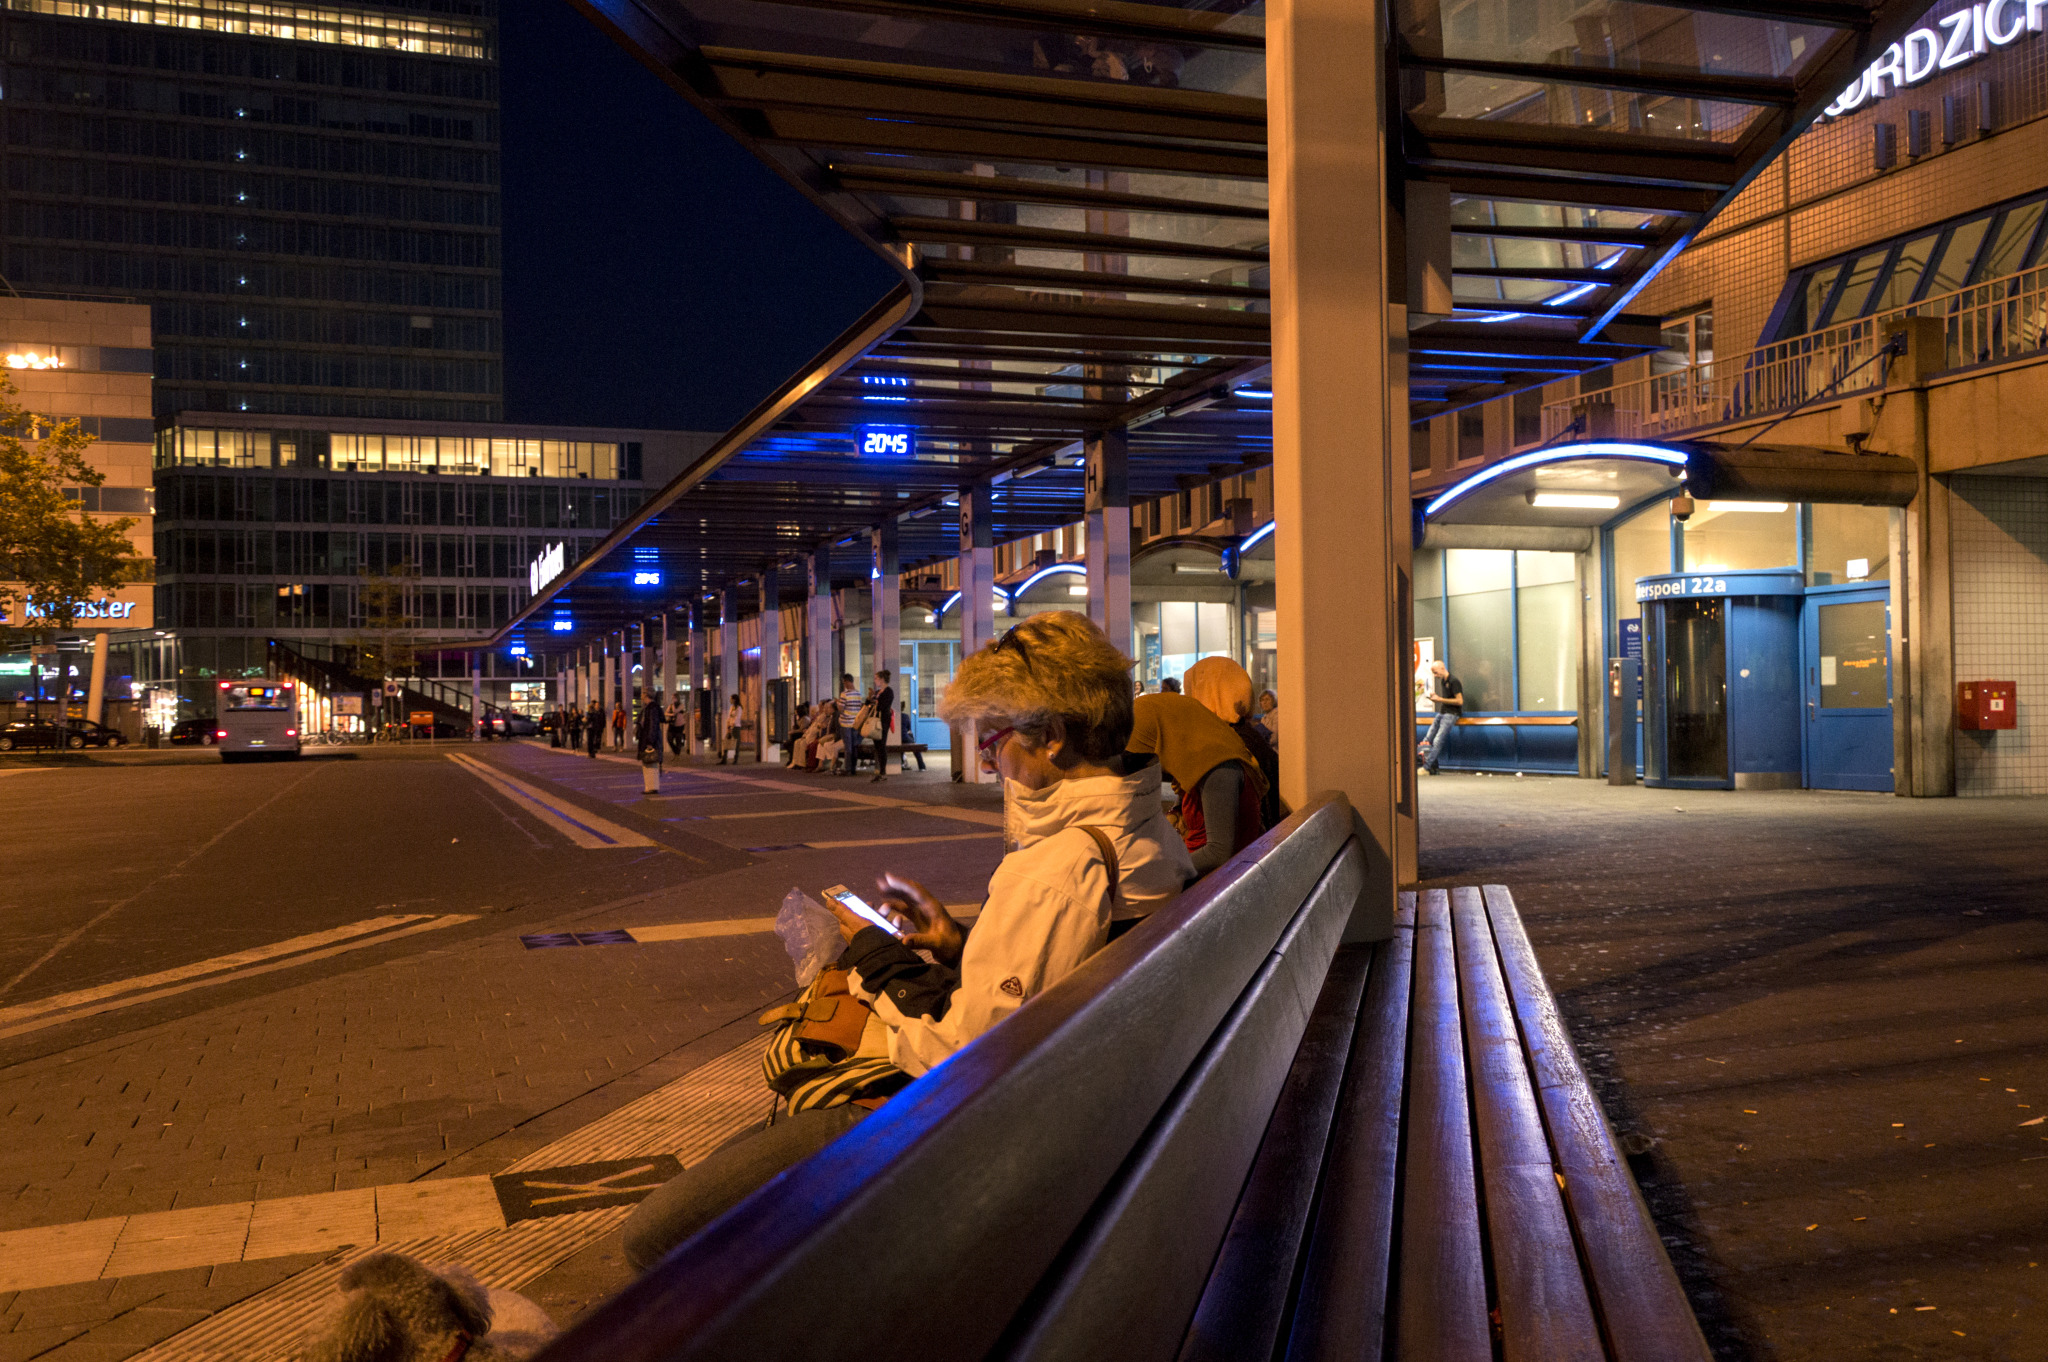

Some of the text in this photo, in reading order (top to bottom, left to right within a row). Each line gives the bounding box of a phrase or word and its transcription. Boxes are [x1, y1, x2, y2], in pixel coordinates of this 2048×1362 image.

[864, 433, 908, 453] 2045
[1087, 463, 1097, 494] H
[961, 511, 969, 537] G
[1691, 577, 1726, 594] 22a
